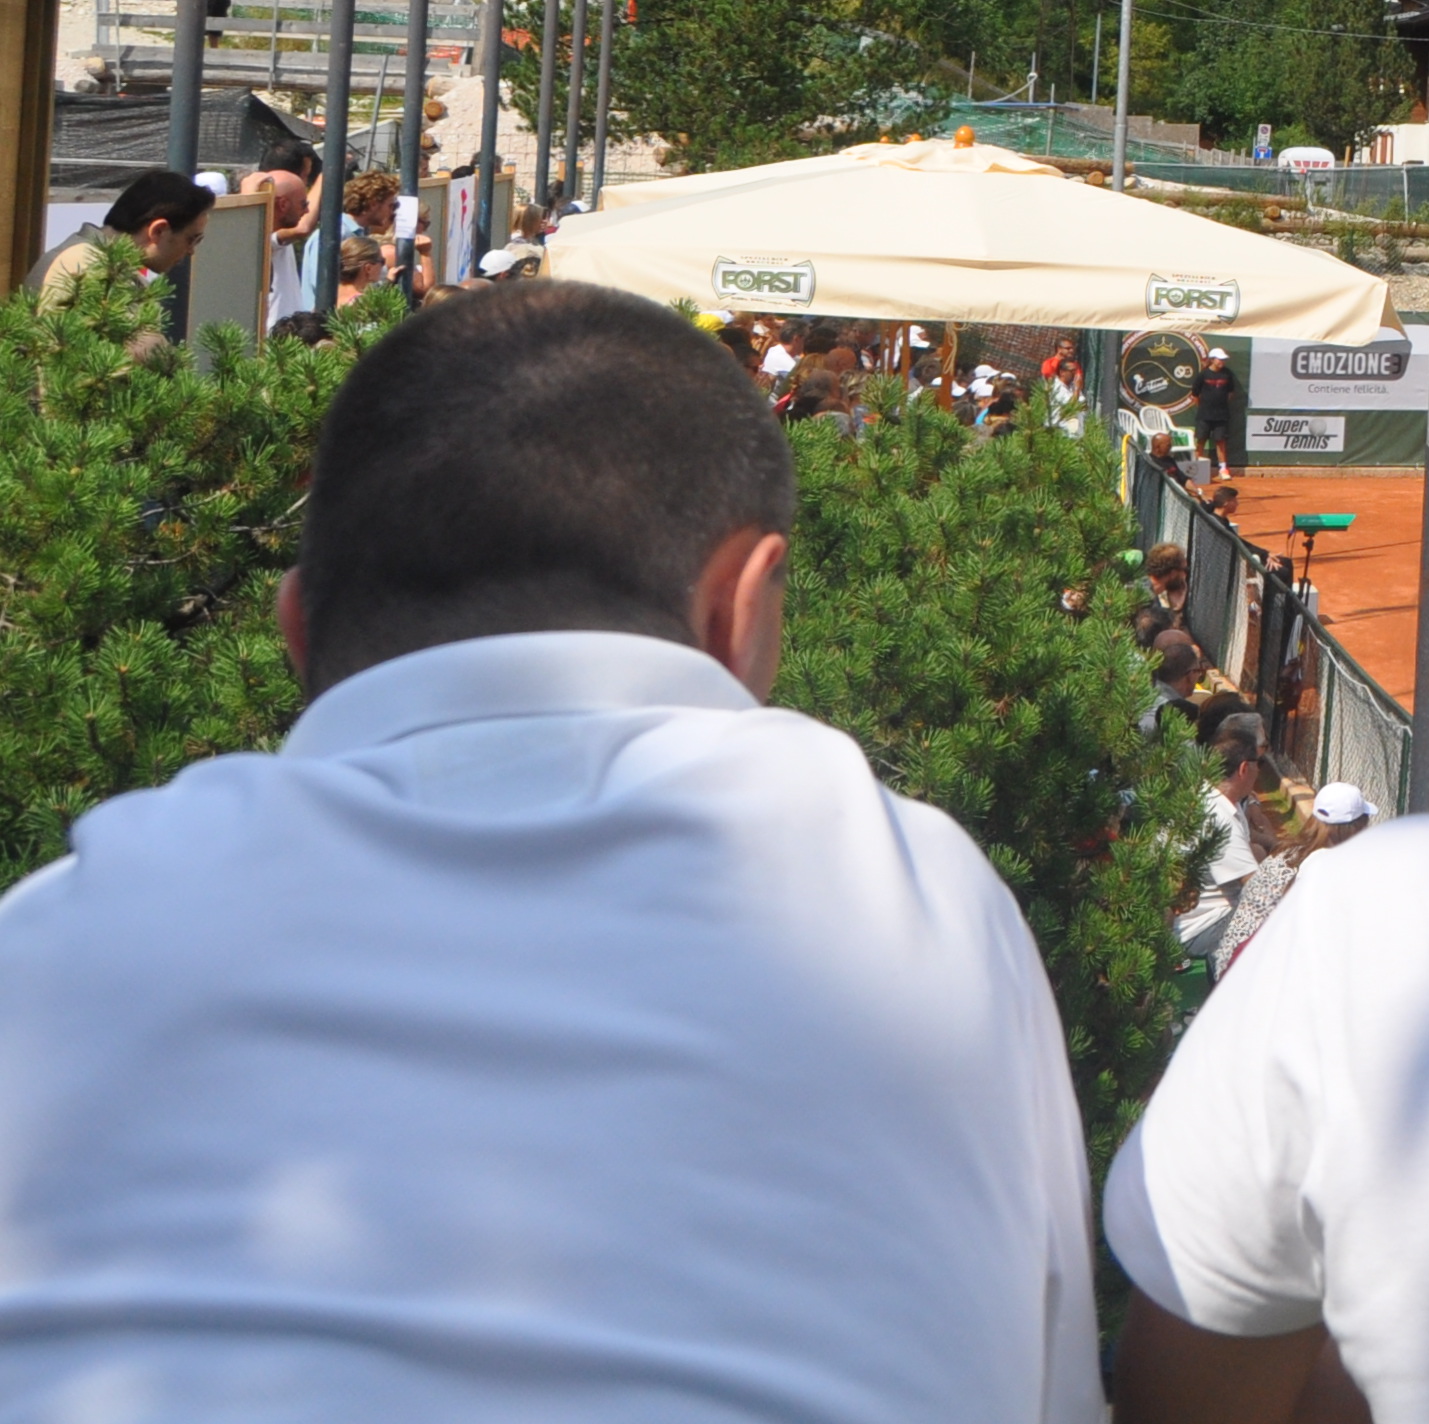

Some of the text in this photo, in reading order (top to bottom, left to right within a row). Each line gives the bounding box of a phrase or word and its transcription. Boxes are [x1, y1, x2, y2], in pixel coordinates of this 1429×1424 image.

[721, 269, 808, 293] FORST
[1153, 286, 1234, 311] FORST
[1308, 384, 1389, 394] Contiene felicità.
[1264, 417, 1308, 435] Super
[1283, 436, 1330, 449] Tennis
